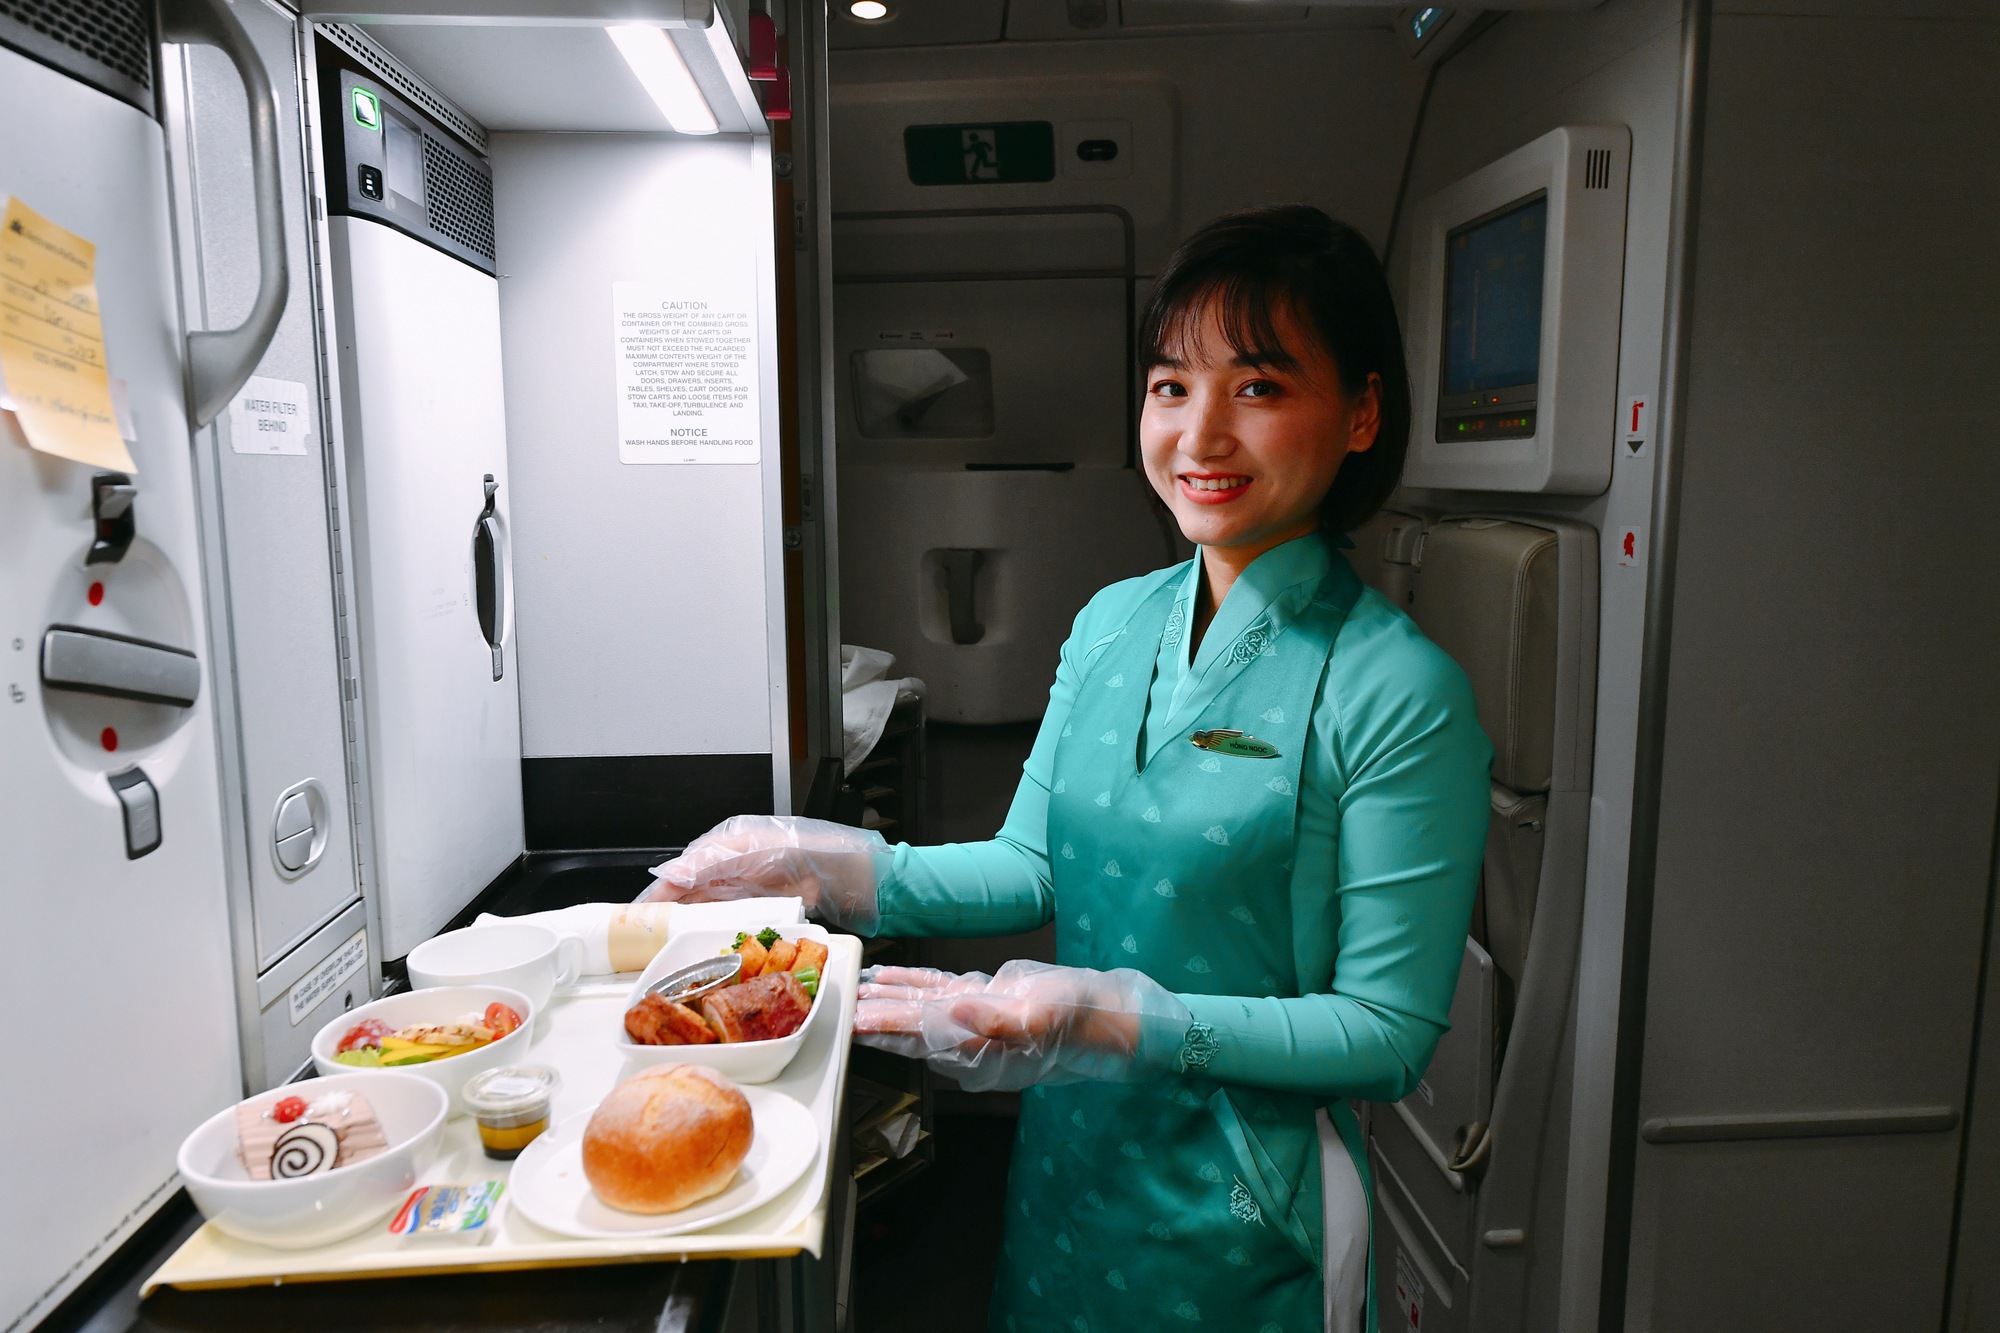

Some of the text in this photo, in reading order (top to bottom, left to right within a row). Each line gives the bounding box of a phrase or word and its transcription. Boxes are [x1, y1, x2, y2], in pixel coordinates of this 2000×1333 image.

[661, 302, 708, 310] CAUTION
[244, 399, 298, 416] WATER FILTER
[258, 419, 287, 432] BEHIND
[670, 428, 708, 436] NOTICE
